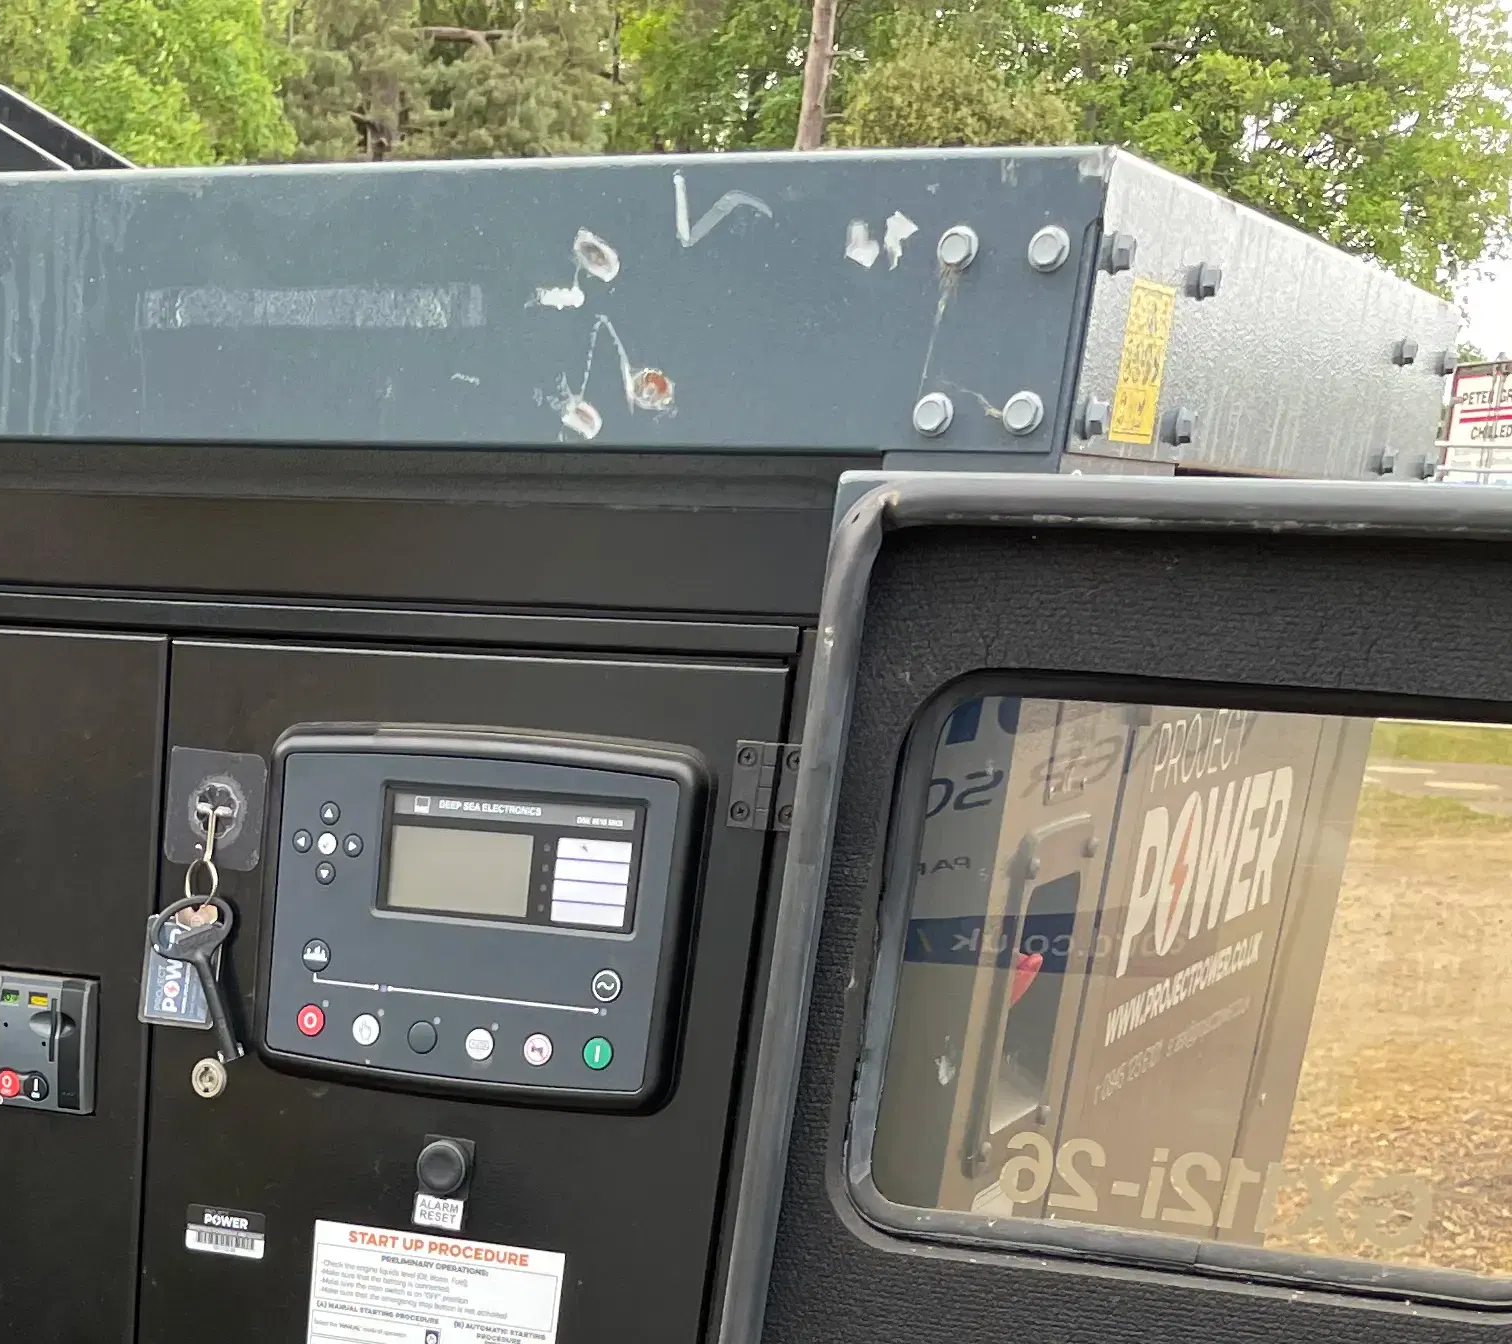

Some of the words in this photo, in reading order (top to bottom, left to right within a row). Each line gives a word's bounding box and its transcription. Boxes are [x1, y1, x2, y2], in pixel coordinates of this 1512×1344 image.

[1150, 709, 1249, 793] PROJECT
[438, 799, 462, 811] DEEP
[463, 801, 481, 812] SEA
[482, 802, 543, 817] ELECTRONICS
[1116, 766, 1293, 979] POWER
[419, 1198, 459, 1214] ALARM
[203, 1213, 249, 1230] POWER
[419, 1209, 456, 1224] RESET
[347, 1229, 399, 1249] START
[401, 1236, 425, 1252] UP
[428, 1240, 529, 1267] PROCEDURE
